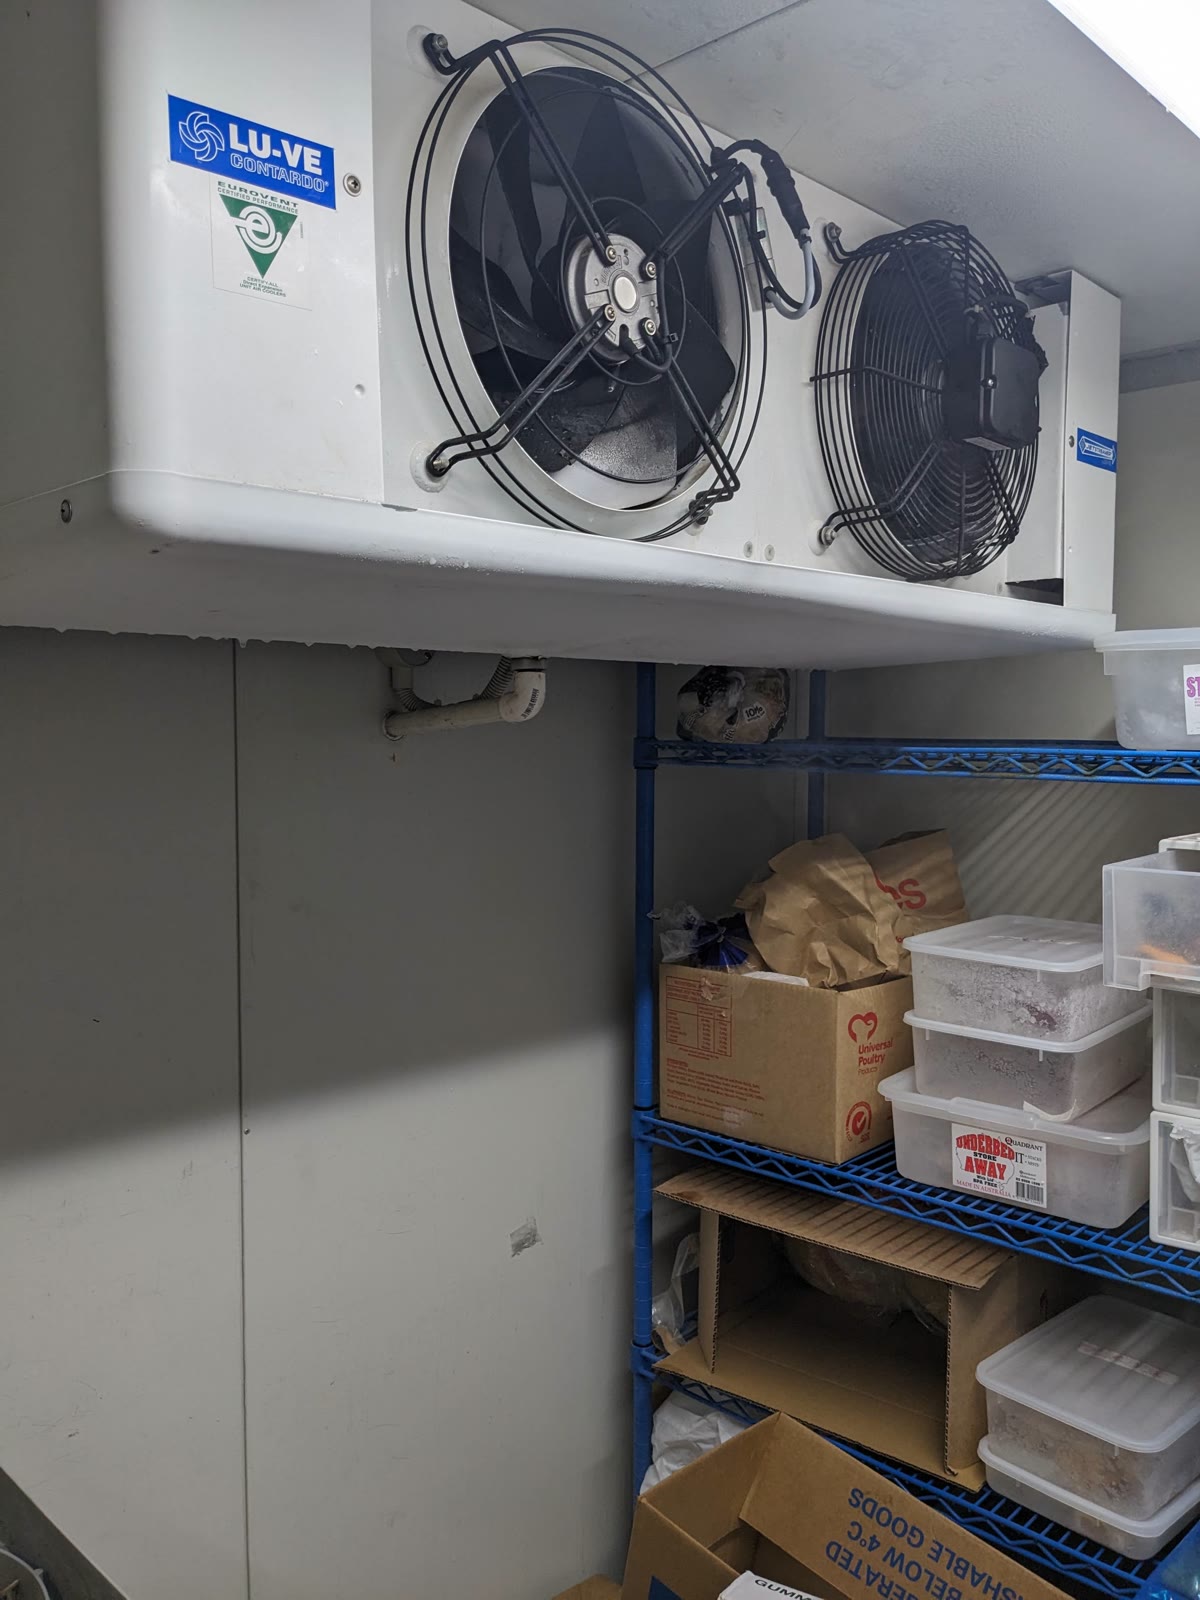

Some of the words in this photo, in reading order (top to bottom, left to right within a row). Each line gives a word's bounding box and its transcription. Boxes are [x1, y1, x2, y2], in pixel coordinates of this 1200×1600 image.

[229, 123, 322, 175] LU-VE
[217, 181, 299, 208] EUROVENT
[217, 187, 251, 201] CERTIFIED
[252, 196, 299, 214] PERFORMANCE
[858, 1037, 893, 1054] Universal
[858, 1053, 886, 1067] Poultry
[956, 1134, 1015, 1160] UNDERBED
[973, 1151, 997, 1161] STORE
[1015, 1151, 1024, 1164] IT
[965, 1156, 1007, 1180] AWAY
[957, 1179, 972, 1188] MADE
[980, 1185, 1011, 1198] AUSTRALIA
[847, 1488, 925, 1548] GOODS
